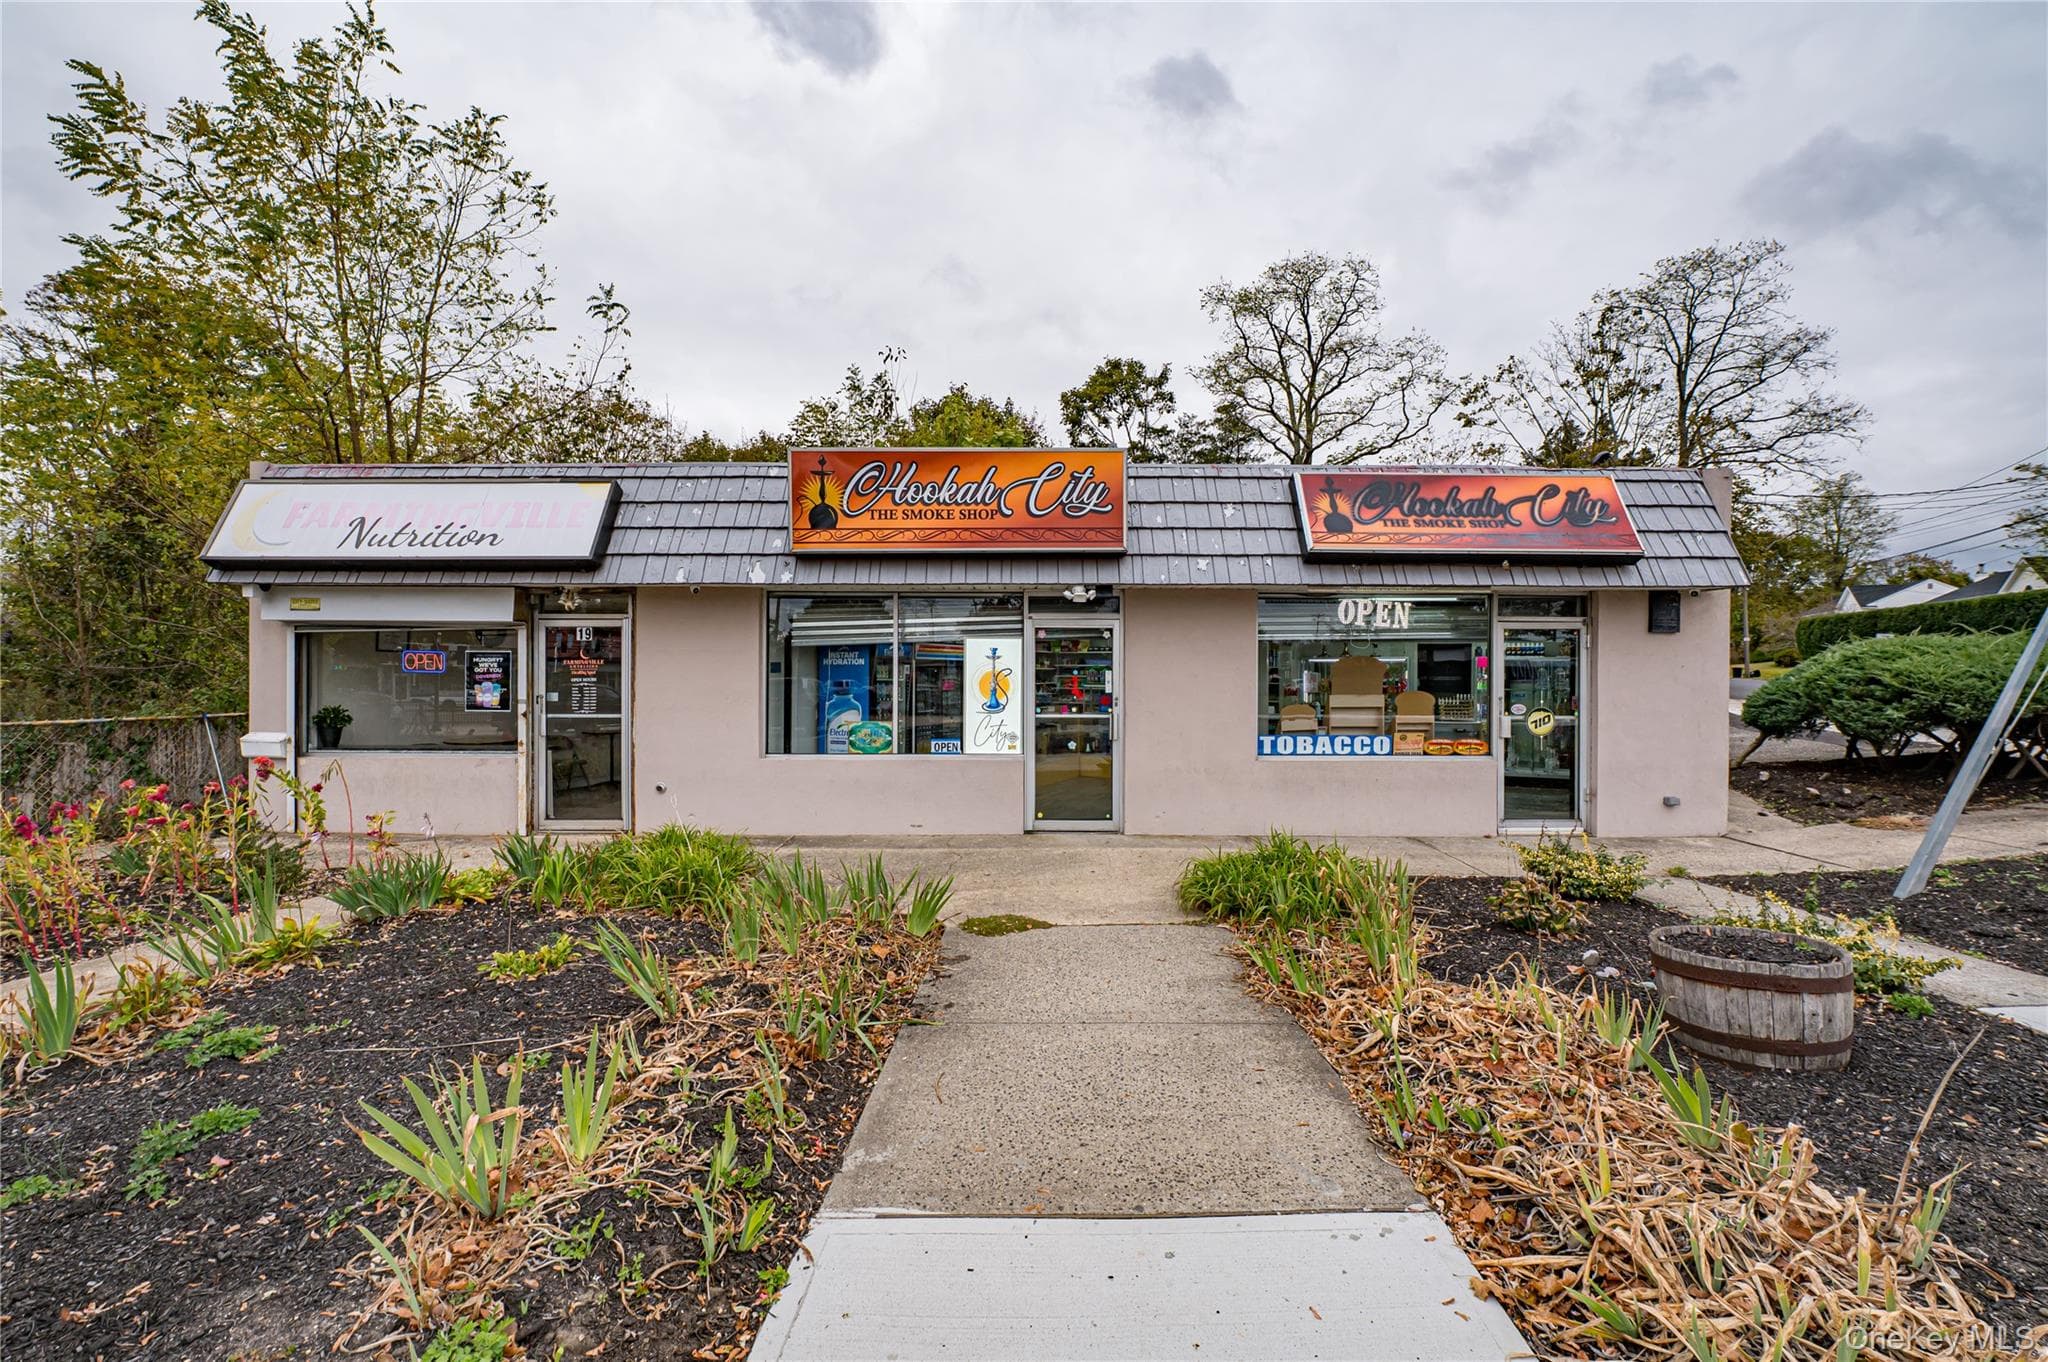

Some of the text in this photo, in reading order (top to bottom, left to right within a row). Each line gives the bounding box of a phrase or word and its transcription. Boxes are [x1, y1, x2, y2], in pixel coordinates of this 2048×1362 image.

[842, 461, 1113, 518] Hookah City
[1353, 479, 1618, 527] Hookah City
[283, 501, 593, 529] FARMINGVILLE
[868, 508, 999, 521] THE SMOKE SHOP
[1381, 518, 1507, 530] THE SMOKE SHOP
[336, 516, 505, 550] Nutrition
[1337, 598, 1412, 629] OPEN
[578, 627, 592, 640] 19
[404, 652, 443, 671] OPEN
[823, 658, 865, 666] HYDRATION
[828, 651, 860, 659] INSTANT
[974, 714, 1009, 752] City
[933, 742, 959, 752] OPEN
[1259, 735, 1391, 755] TOBACCO
